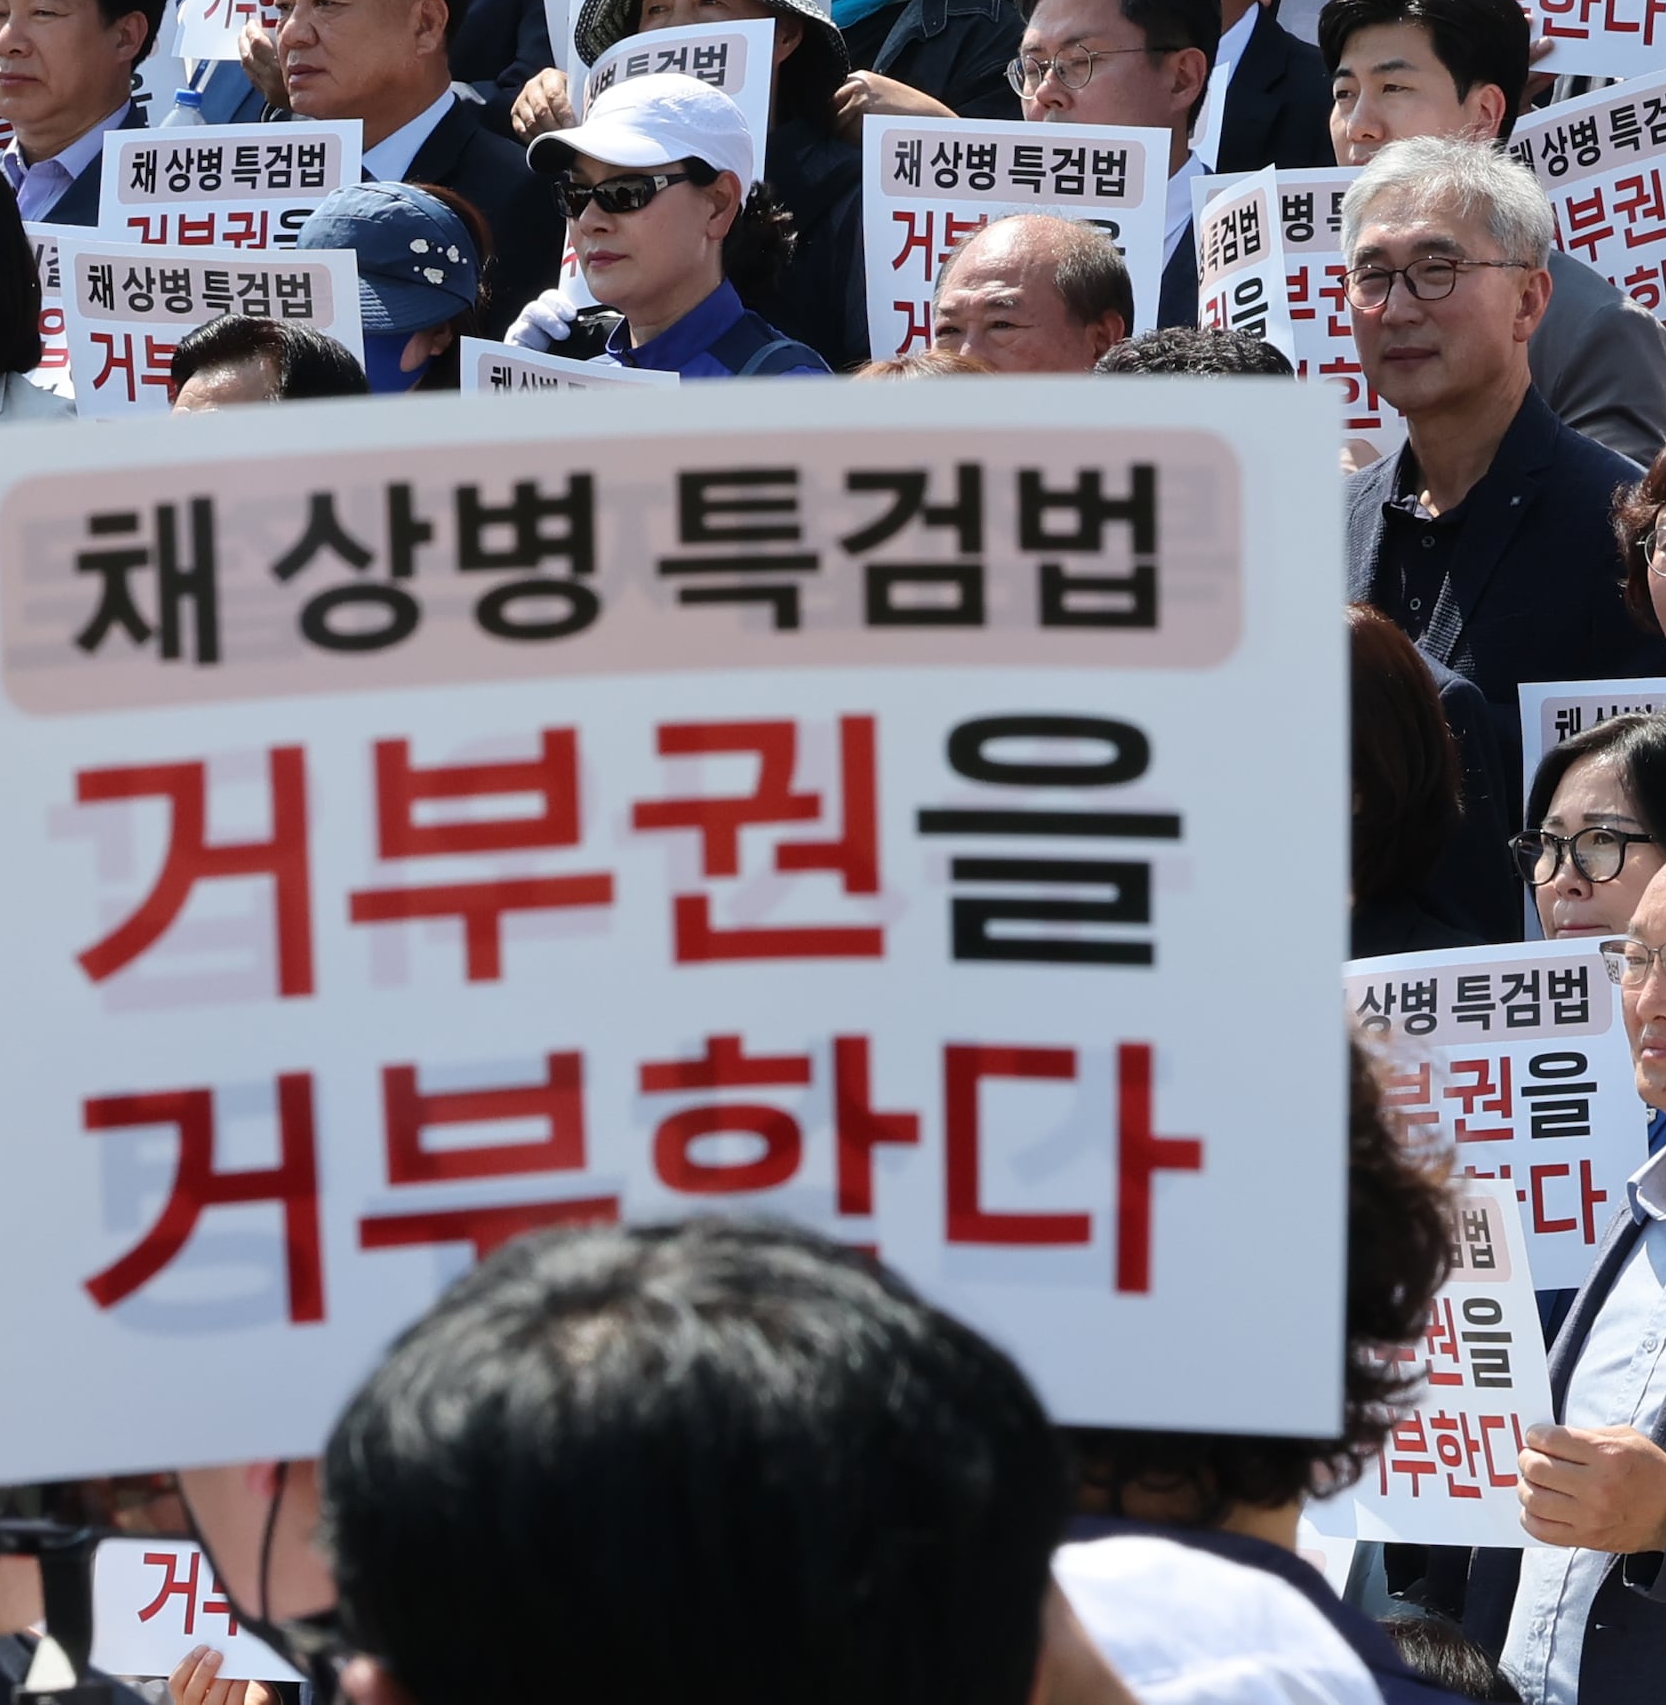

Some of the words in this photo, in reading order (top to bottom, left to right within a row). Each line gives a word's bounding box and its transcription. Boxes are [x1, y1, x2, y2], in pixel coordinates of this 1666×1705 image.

[130, 152, 157, 194] 채
[164, 145, 223, 192] 상병
[230, 141, 327, 190] 특검법
[893, 139, 922, 187] 채
[930, 141, 998, 191] 상병
[1007, 144, 1128, 197] 특검법
[1540, 115, 1601, 177] 상병
[87, 267, 114, 310] 채
[122, 266, 193, 315] 상병
[200, 269, 313, 319] 특검법
[75, 493, 223, 667] 채
[271, 467, 605, 652] 상병
[655, 459, 1162, 633] 특검법
[73, 711, 1184, 999] 거부권을
[1356, 976, 1439, 1036] 상병
[1450, 965, 1590, 1032] 특검법
[83, 1032, 1205, 1325] 거부한다
